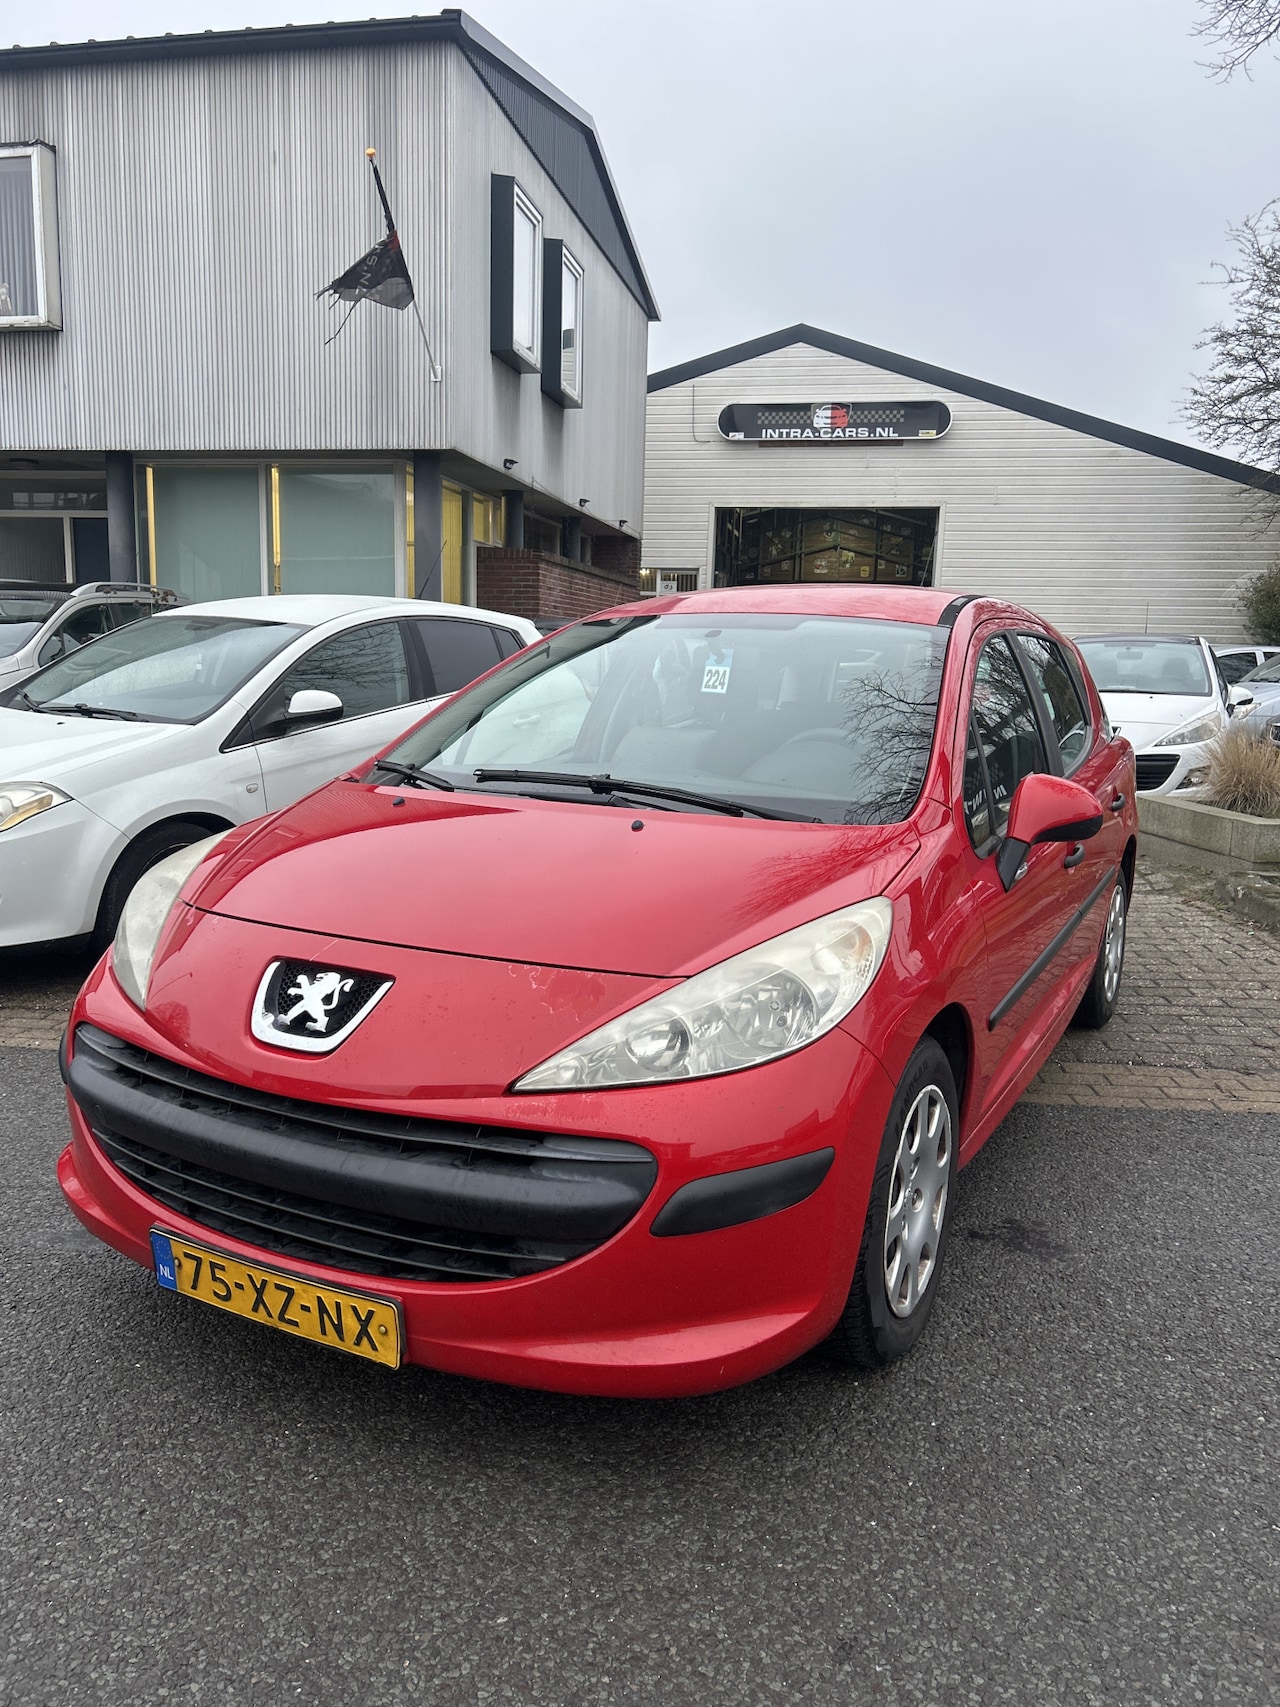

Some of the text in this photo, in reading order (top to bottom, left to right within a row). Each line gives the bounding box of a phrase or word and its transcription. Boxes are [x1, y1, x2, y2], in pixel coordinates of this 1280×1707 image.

[761, 427, 899, 439] INTRA-CARS.NL
[703, 669, 727, 690] 224
[159, 1263, 175, 1281] NL
[183, 1250, 379, 1352] 75-XZ-NX
